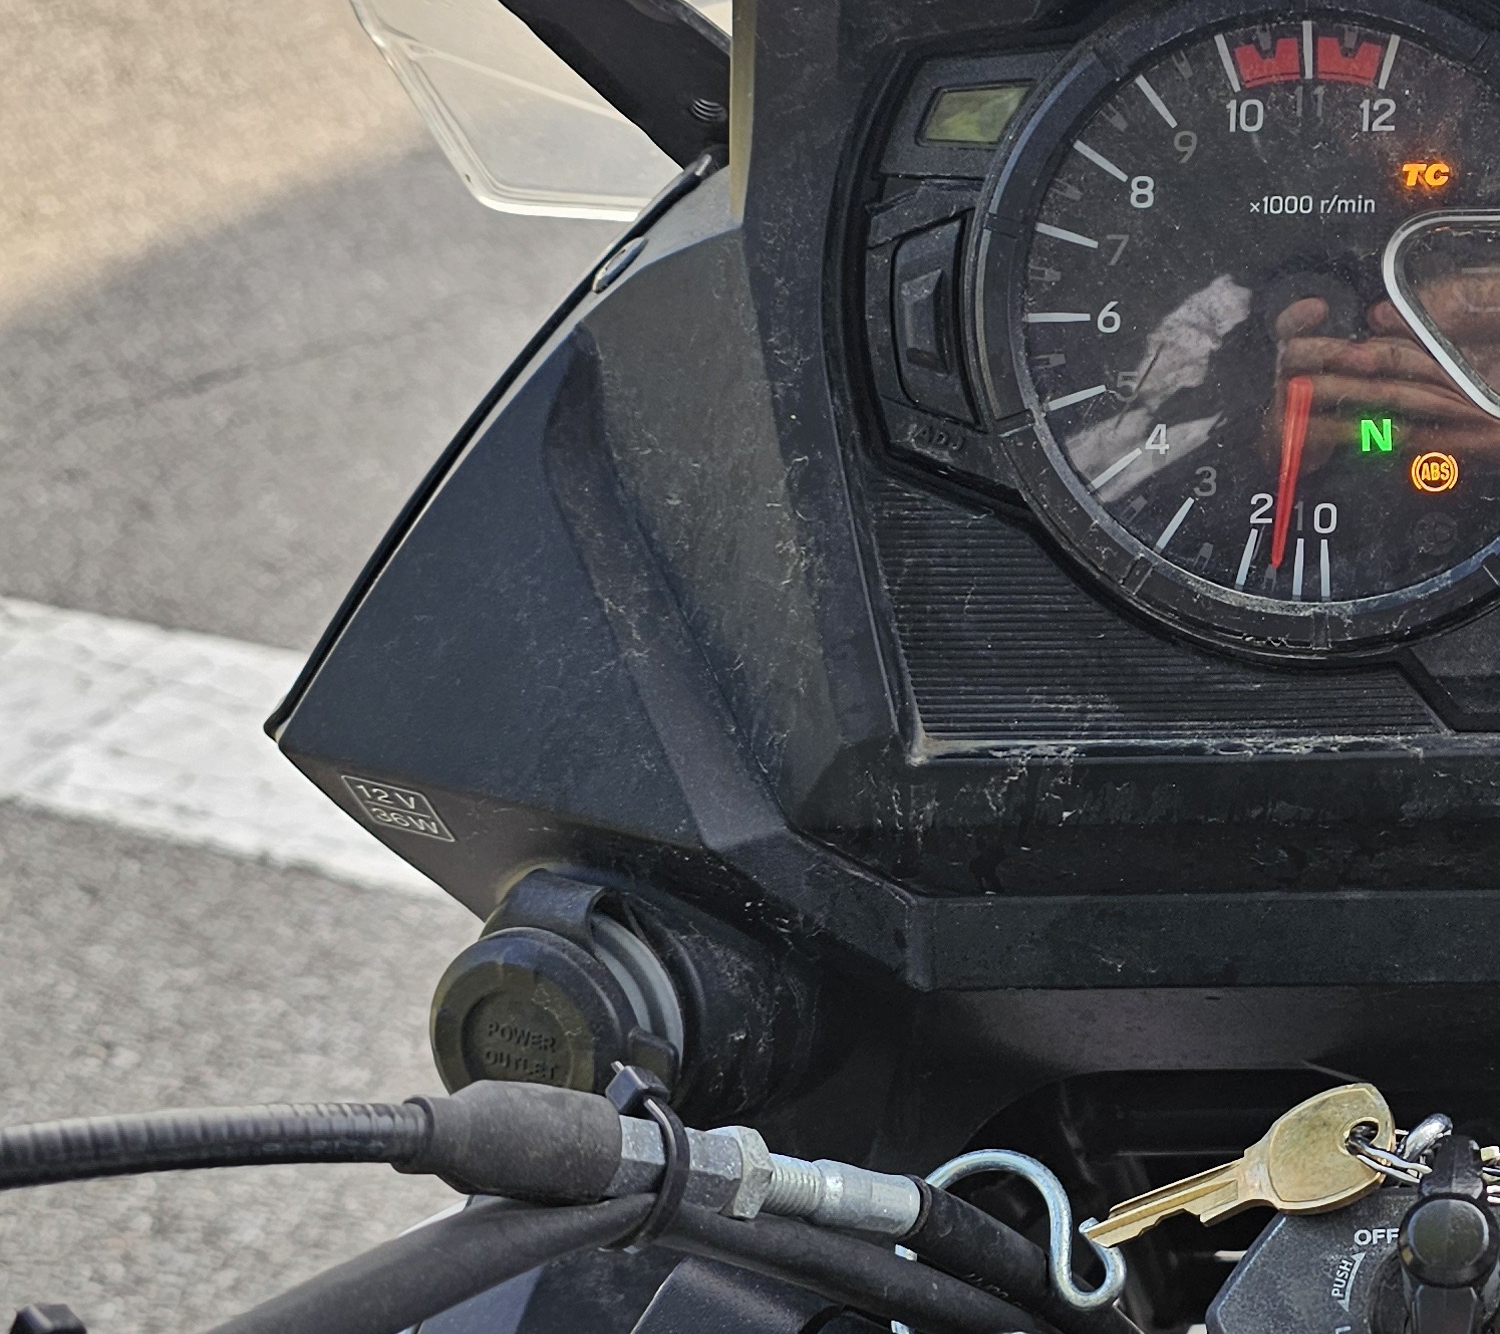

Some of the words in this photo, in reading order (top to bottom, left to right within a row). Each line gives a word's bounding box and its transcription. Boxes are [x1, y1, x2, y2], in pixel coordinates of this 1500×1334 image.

[1225, 98, 1265, 133] 10
[1359, 97, 1397, 132] 12
[1173, 130, 1198, 165] 9
[1402, 162, 1451, 187] TC
[1129, 175, 1155, 209] 8
[1320, 194, 1376, 215] r/min
[1105, 234, 1130, 266] 7
[1096, 300, 1122, 334] 6
[1113, 371, 1139, 403] 5
[1144, 423, 1170, 455] 4
[1360, 418, 1393, 452] N
[1193, 465, 1217, 497] 3
[1420, 462, 1451, 482] ABS
[1249, 492, 1274, 524] 2
[1313, 503, 1338, 534] 0
[371, 807, 439, 834] 36W
[487, 1021, 557, 1054] POWER
[484, 1050, 561, 1081] OUTLET
[1353, 1227, 1400, 1246] OFF
[1331, 1259, 1354, 1299] PUSH
